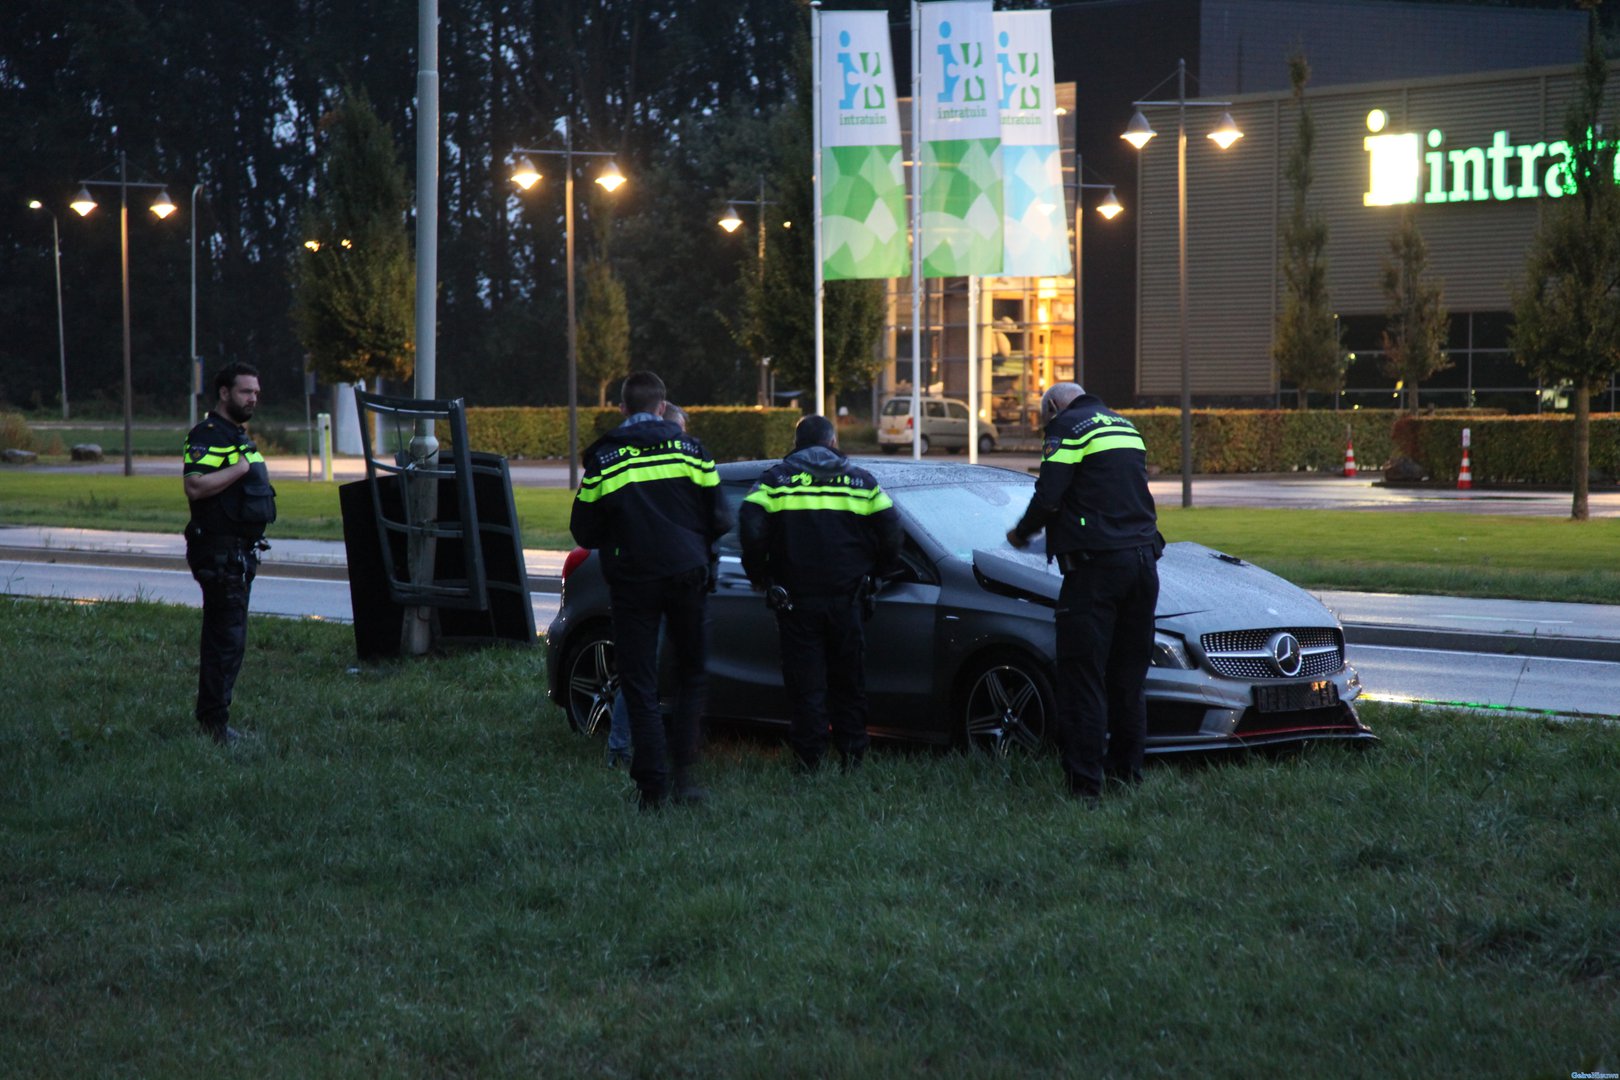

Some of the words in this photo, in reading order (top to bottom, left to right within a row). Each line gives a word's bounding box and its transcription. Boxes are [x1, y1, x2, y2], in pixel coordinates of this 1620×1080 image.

[839, 113, 887, 126] intratuin
[938, 106, 988, 120] intratuin
[1000, 115, 1042, 125] ntratuin
